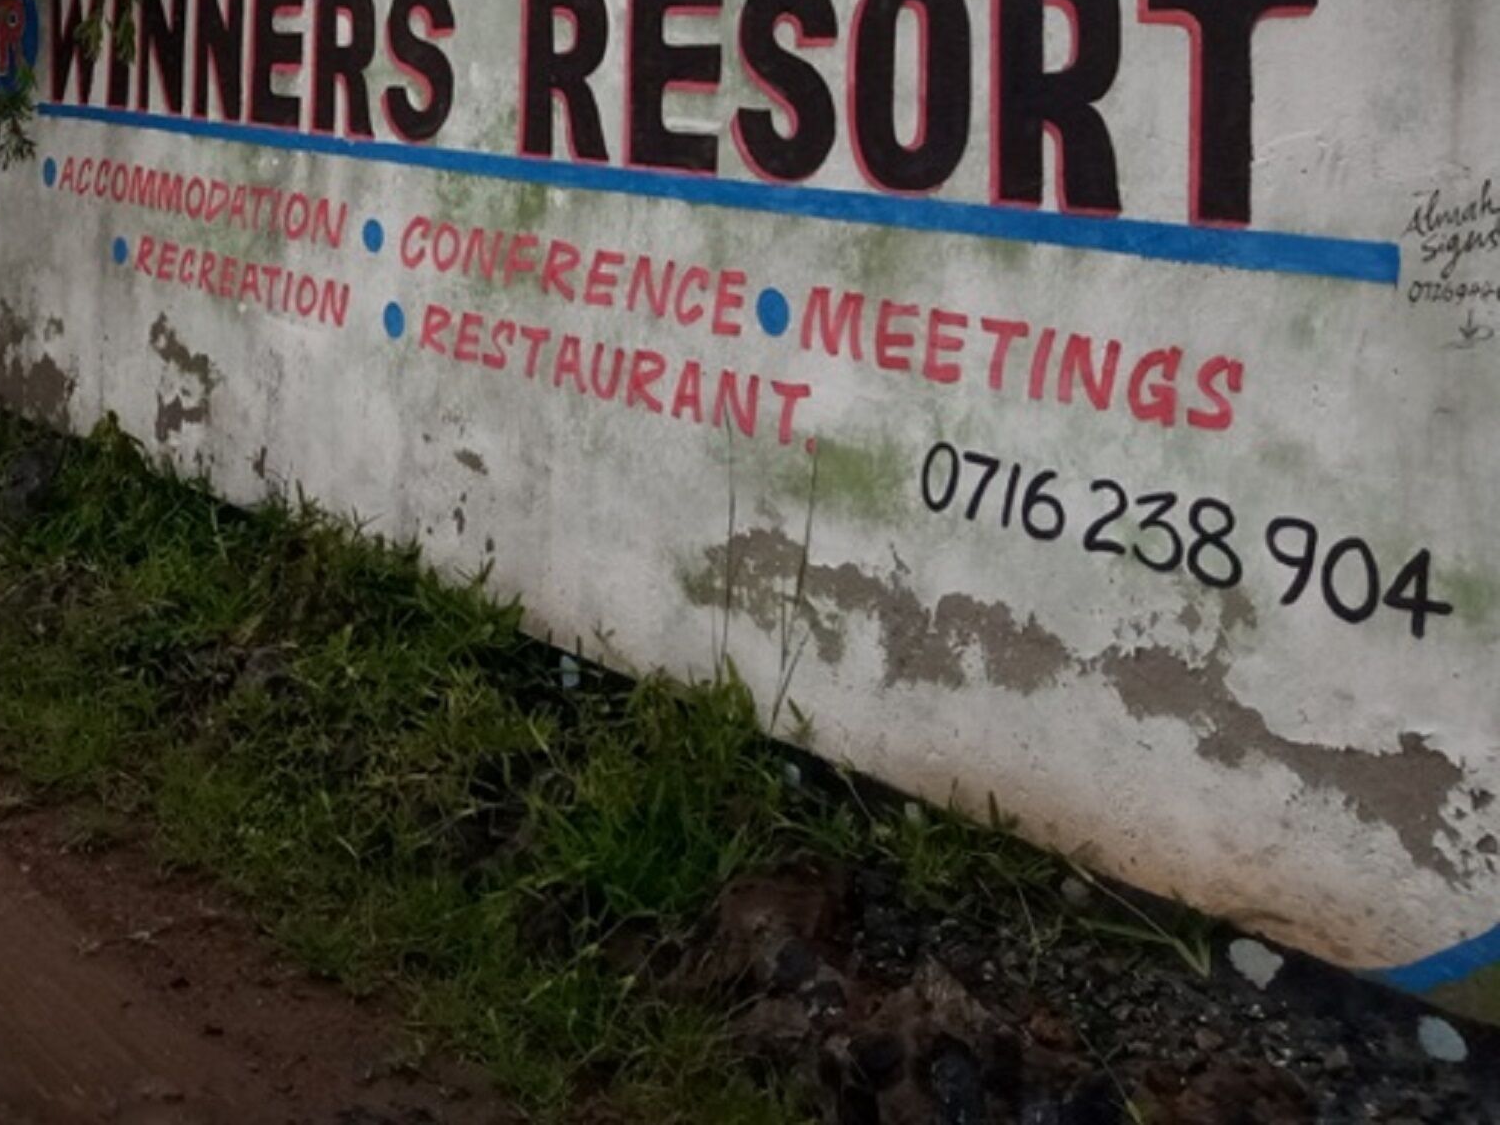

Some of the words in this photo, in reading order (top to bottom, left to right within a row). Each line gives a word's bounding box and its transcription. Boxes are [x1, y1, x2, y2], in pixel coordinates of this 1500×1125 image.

[57, 155, 349, 249] ACCOMMODATION
[400, 215, 747, 338] CONFRENCE
[799, 285, 1246, 432] MEETINGS
[133, 234, 351, 328] RECREATION
[921, 441, 1067, 541] 0716
[1082, 479, 1244, 590] 238
[1264, 516, 1455, 639] 904
